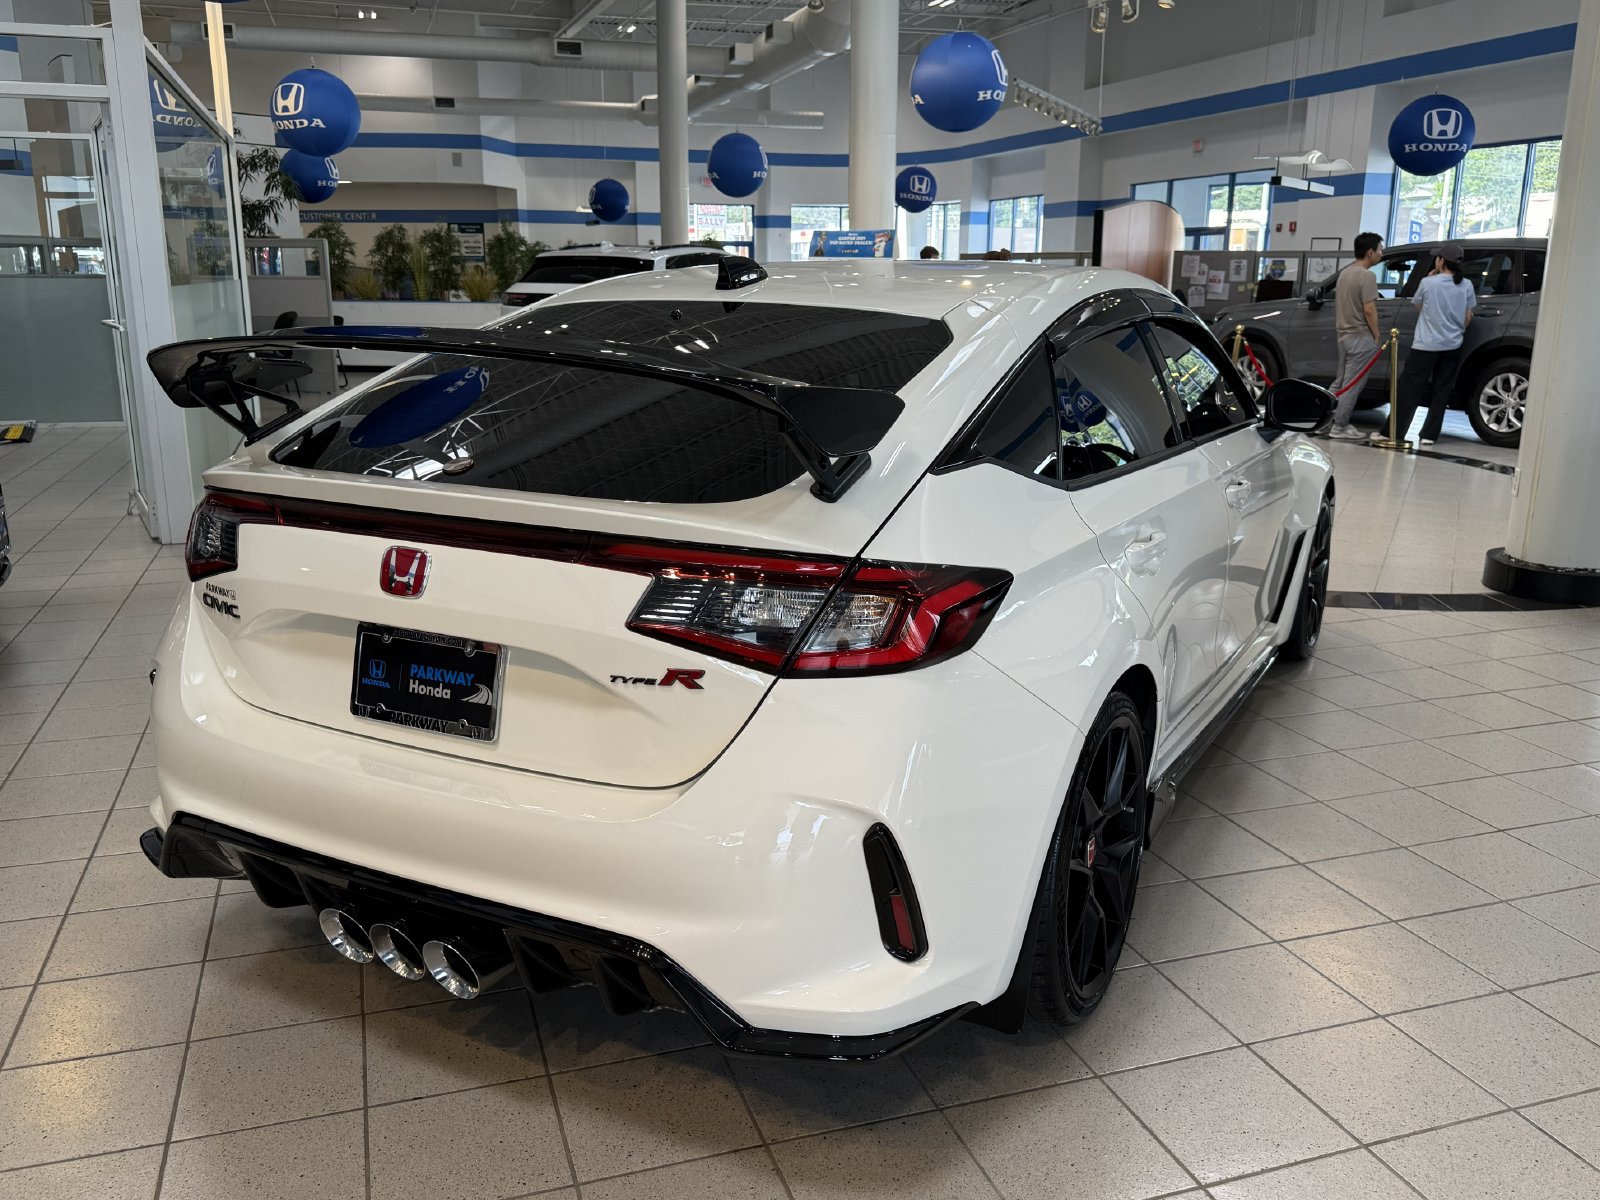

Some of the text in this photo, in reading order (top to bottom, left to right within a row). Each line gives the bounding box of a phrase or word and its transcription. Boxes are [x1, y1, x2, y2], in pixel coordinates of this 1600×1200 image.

[1404, 143, 1467, 153] HONDA
[203, 592, 240, 618] CIVIC
[361, 677, 391, 689] HONDA
[410, 663, 476, 687] PARKWAY
[609, 668, 705, 690] TYPE R
[409, 679, 452, 699] Honda
[390, 711, 448, 734] PARKWAY
